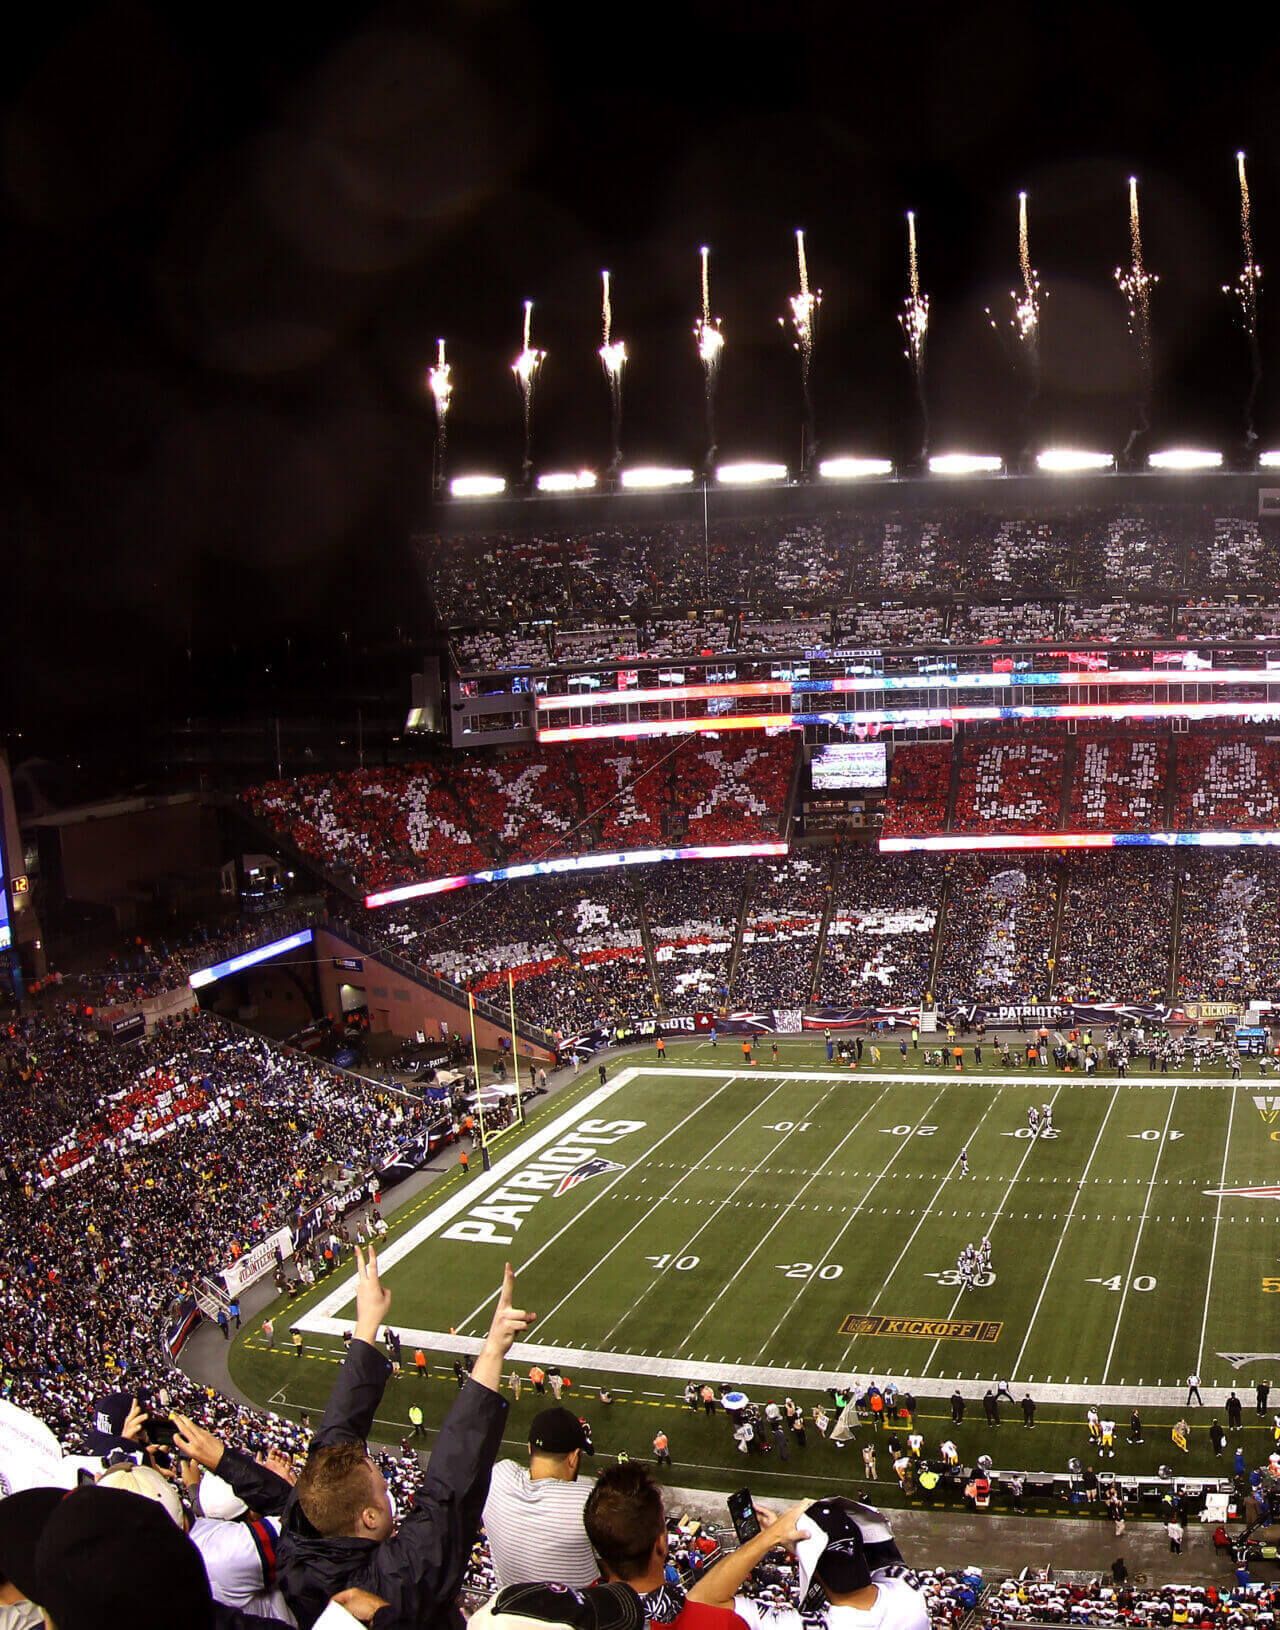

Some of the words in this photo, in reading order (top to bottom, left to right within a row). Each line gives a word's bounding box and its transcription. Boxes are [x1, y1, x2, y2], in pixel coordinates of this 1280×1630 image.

[15, 878, 26, 891] 12
[1000, 1005, 1062, 1018] PATRIOTS
[1201, 1004, 1238, 1017] KICKOFF
[440, 1118, 647, 1245] PATRIOTS
[653, 1254, 701, 1270] 10
[785, 1262, 844, 1280] 20
[1100, 1274, 1158, 1292] 40
[886, 1320, 974, 1337] KICKOFF
